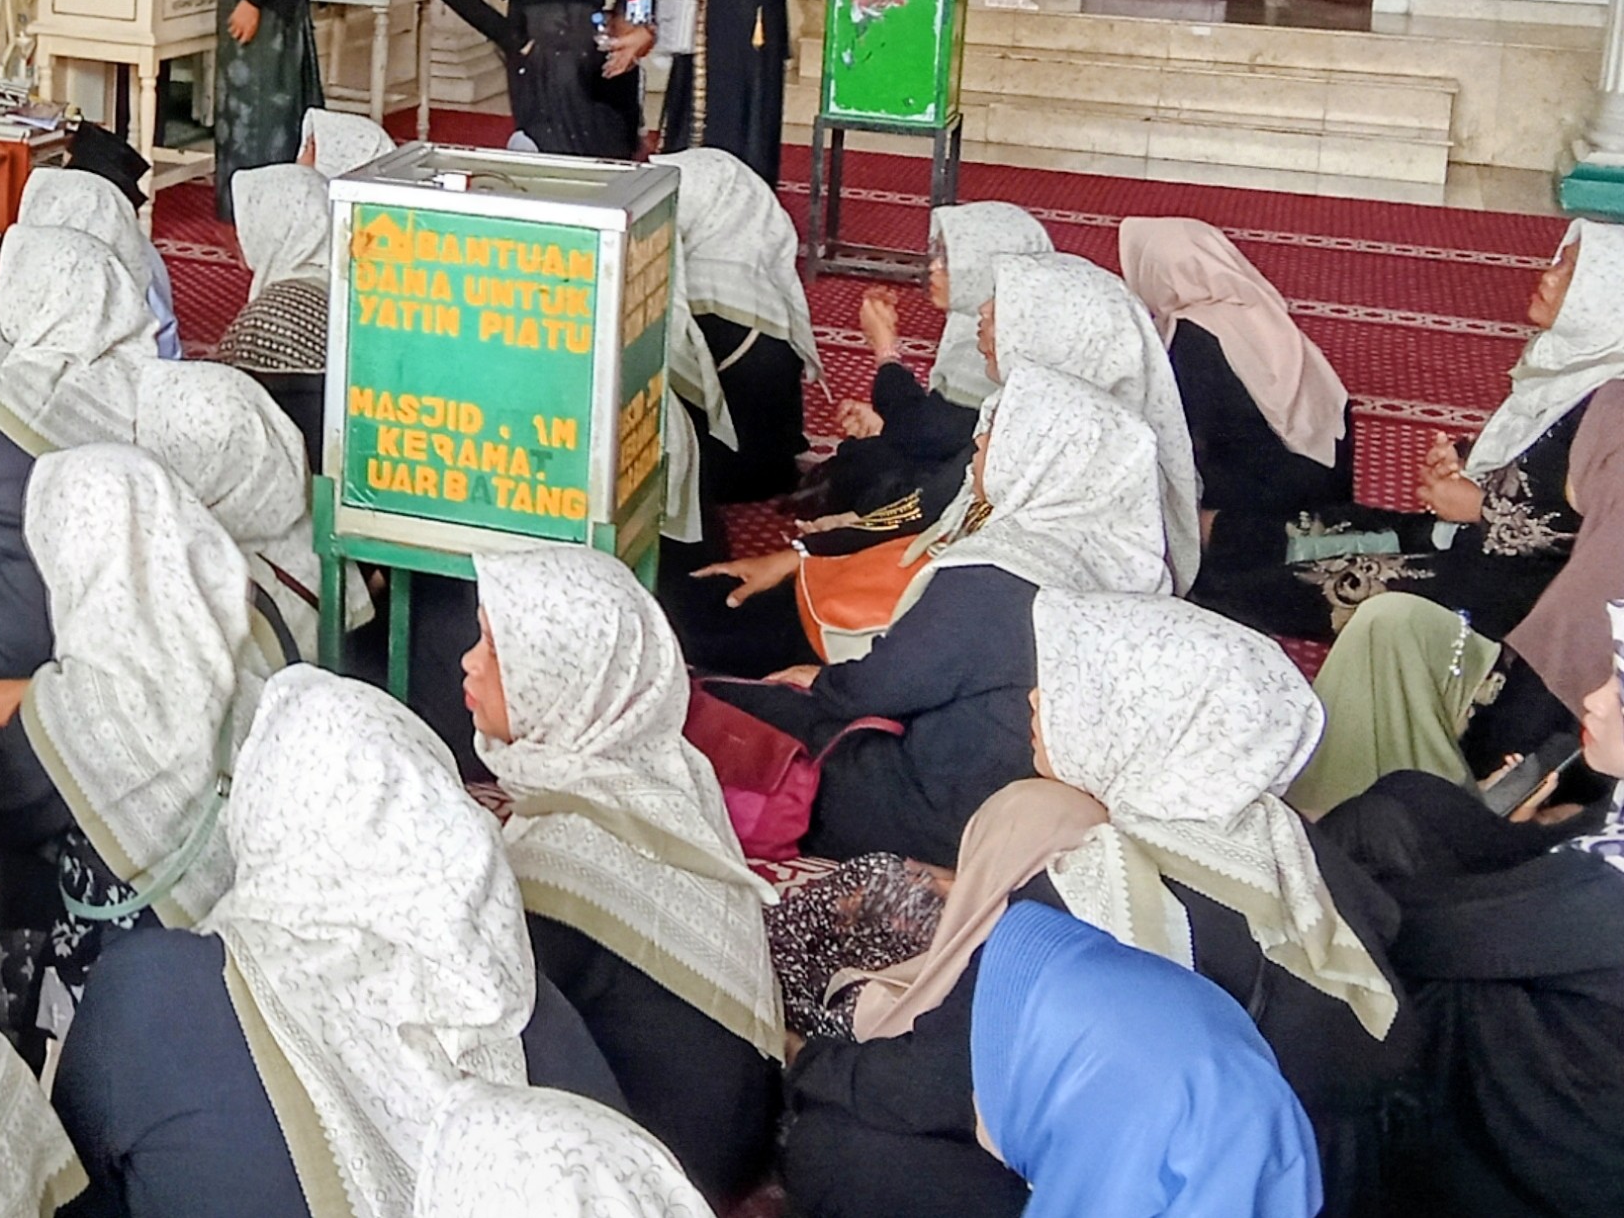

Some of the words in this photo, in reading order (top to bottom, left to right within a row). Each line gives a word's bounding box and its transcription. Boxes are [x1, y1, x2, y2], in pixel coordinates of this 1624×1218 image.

[416, 228, 595, 280] BANTUAN
[355, 261, 453, 302] DANA
[463, 274, 591, 318] UNTUK
[479, 310, 592, 354] PIATU
[347, 385, 484, 436] MASJID
